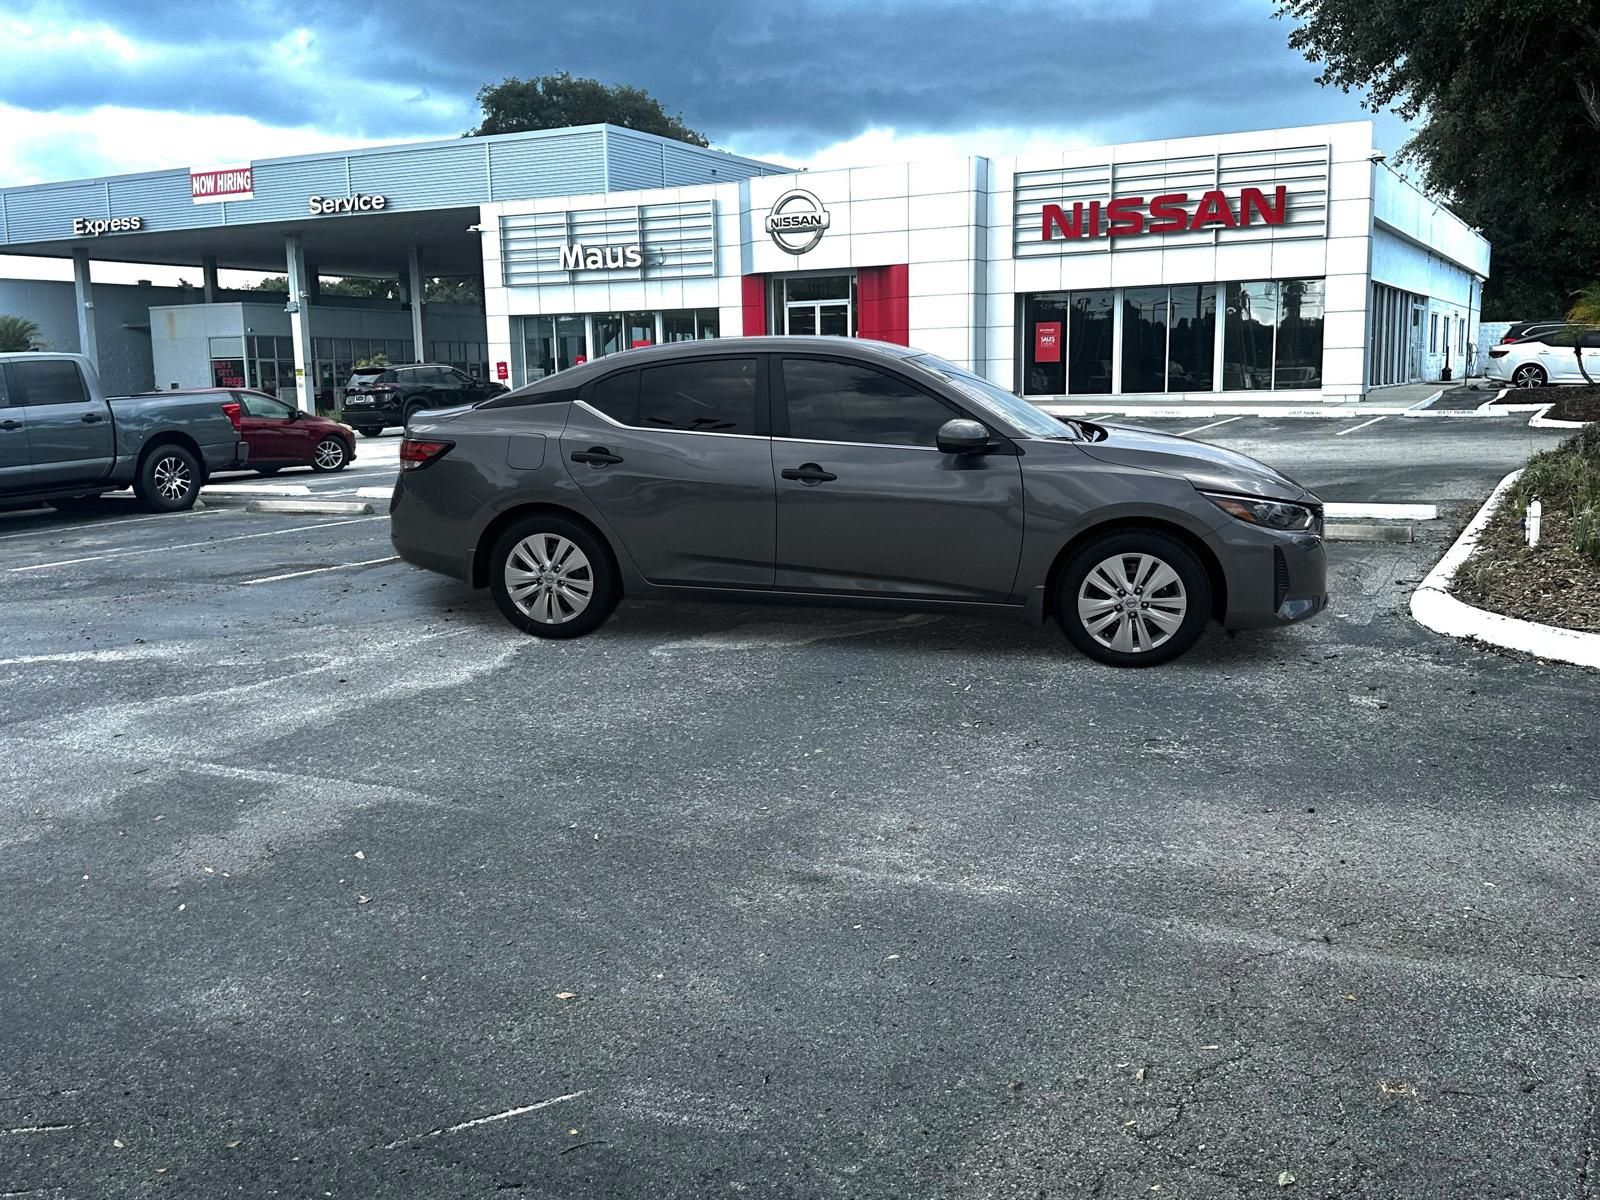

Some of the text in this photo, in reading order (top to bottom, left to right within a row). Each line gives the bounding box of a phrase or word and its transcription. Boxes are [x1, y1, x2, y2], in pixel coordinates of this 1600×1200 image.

[192, 171, 251, 195] NOW HIRING
[308, 192, 385, 214] Service
[1041, 185, 1287, 241] NISSAN
[73, 216, 141, 237] Express
[770, 215, 822, 228] NISSAN
[559, 243, 642, 270] Maus
[222, 377, 245, 387] FREE
